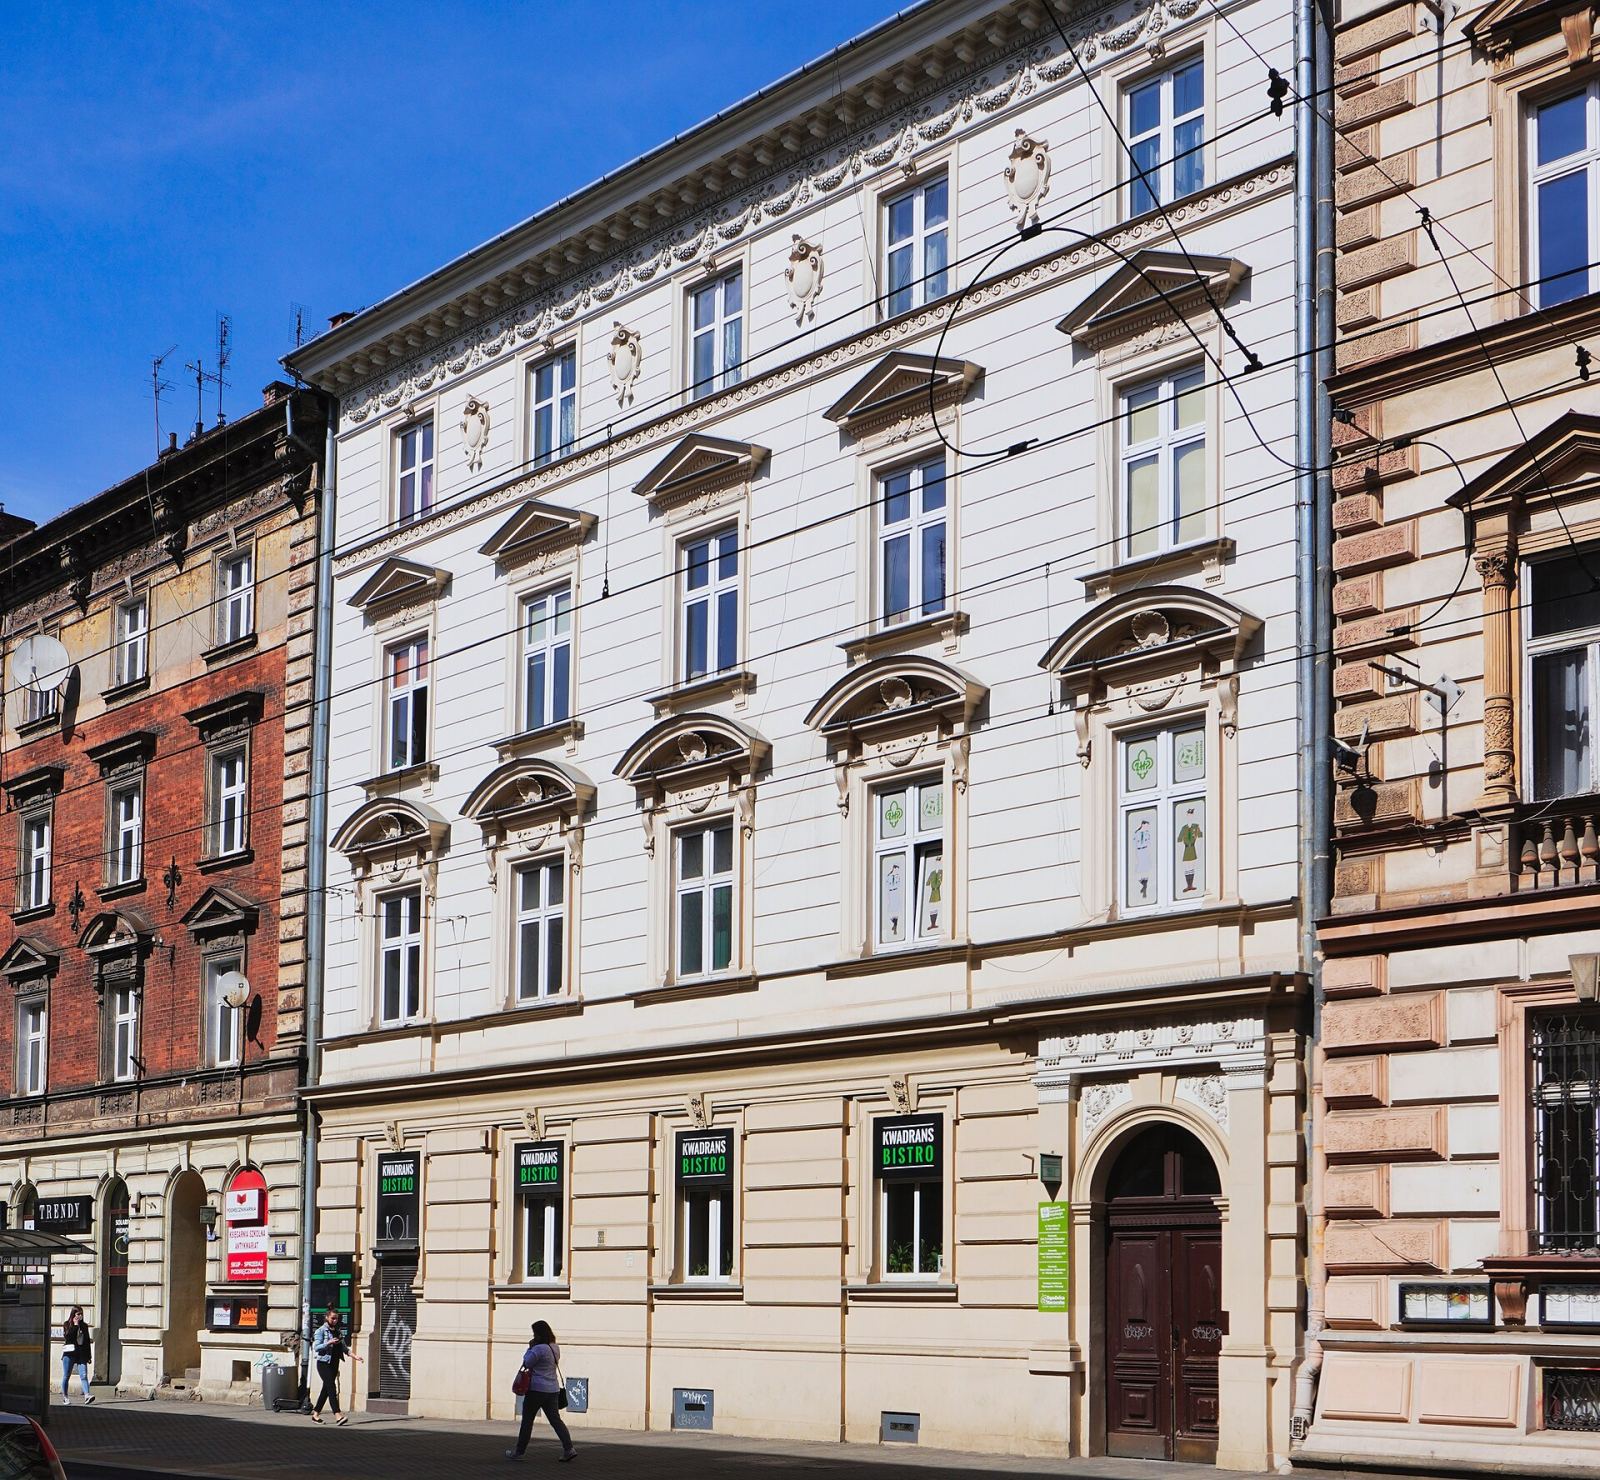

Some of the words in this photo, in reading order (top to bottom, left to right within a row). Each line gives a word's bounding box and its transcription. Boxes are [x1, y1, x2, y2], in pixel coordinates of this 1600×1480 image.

[882, 1127, 935, 1146] KWADRANS
[682, 1138, 726, 1156] KWADRANS
[882, 1144, 935, 1166] BISTRO
[520, 1150, 559, 1166] KWADRANS
[682, 1155, 726, 1176] BISTRO
[382, 1161, 415, 1178] KWADRANS
[520, 1165, 558, 1184] BISTRO
[382, 1177, 414, 1194] BISTRO
[39, 1202, 80, 1220] TRENDY
